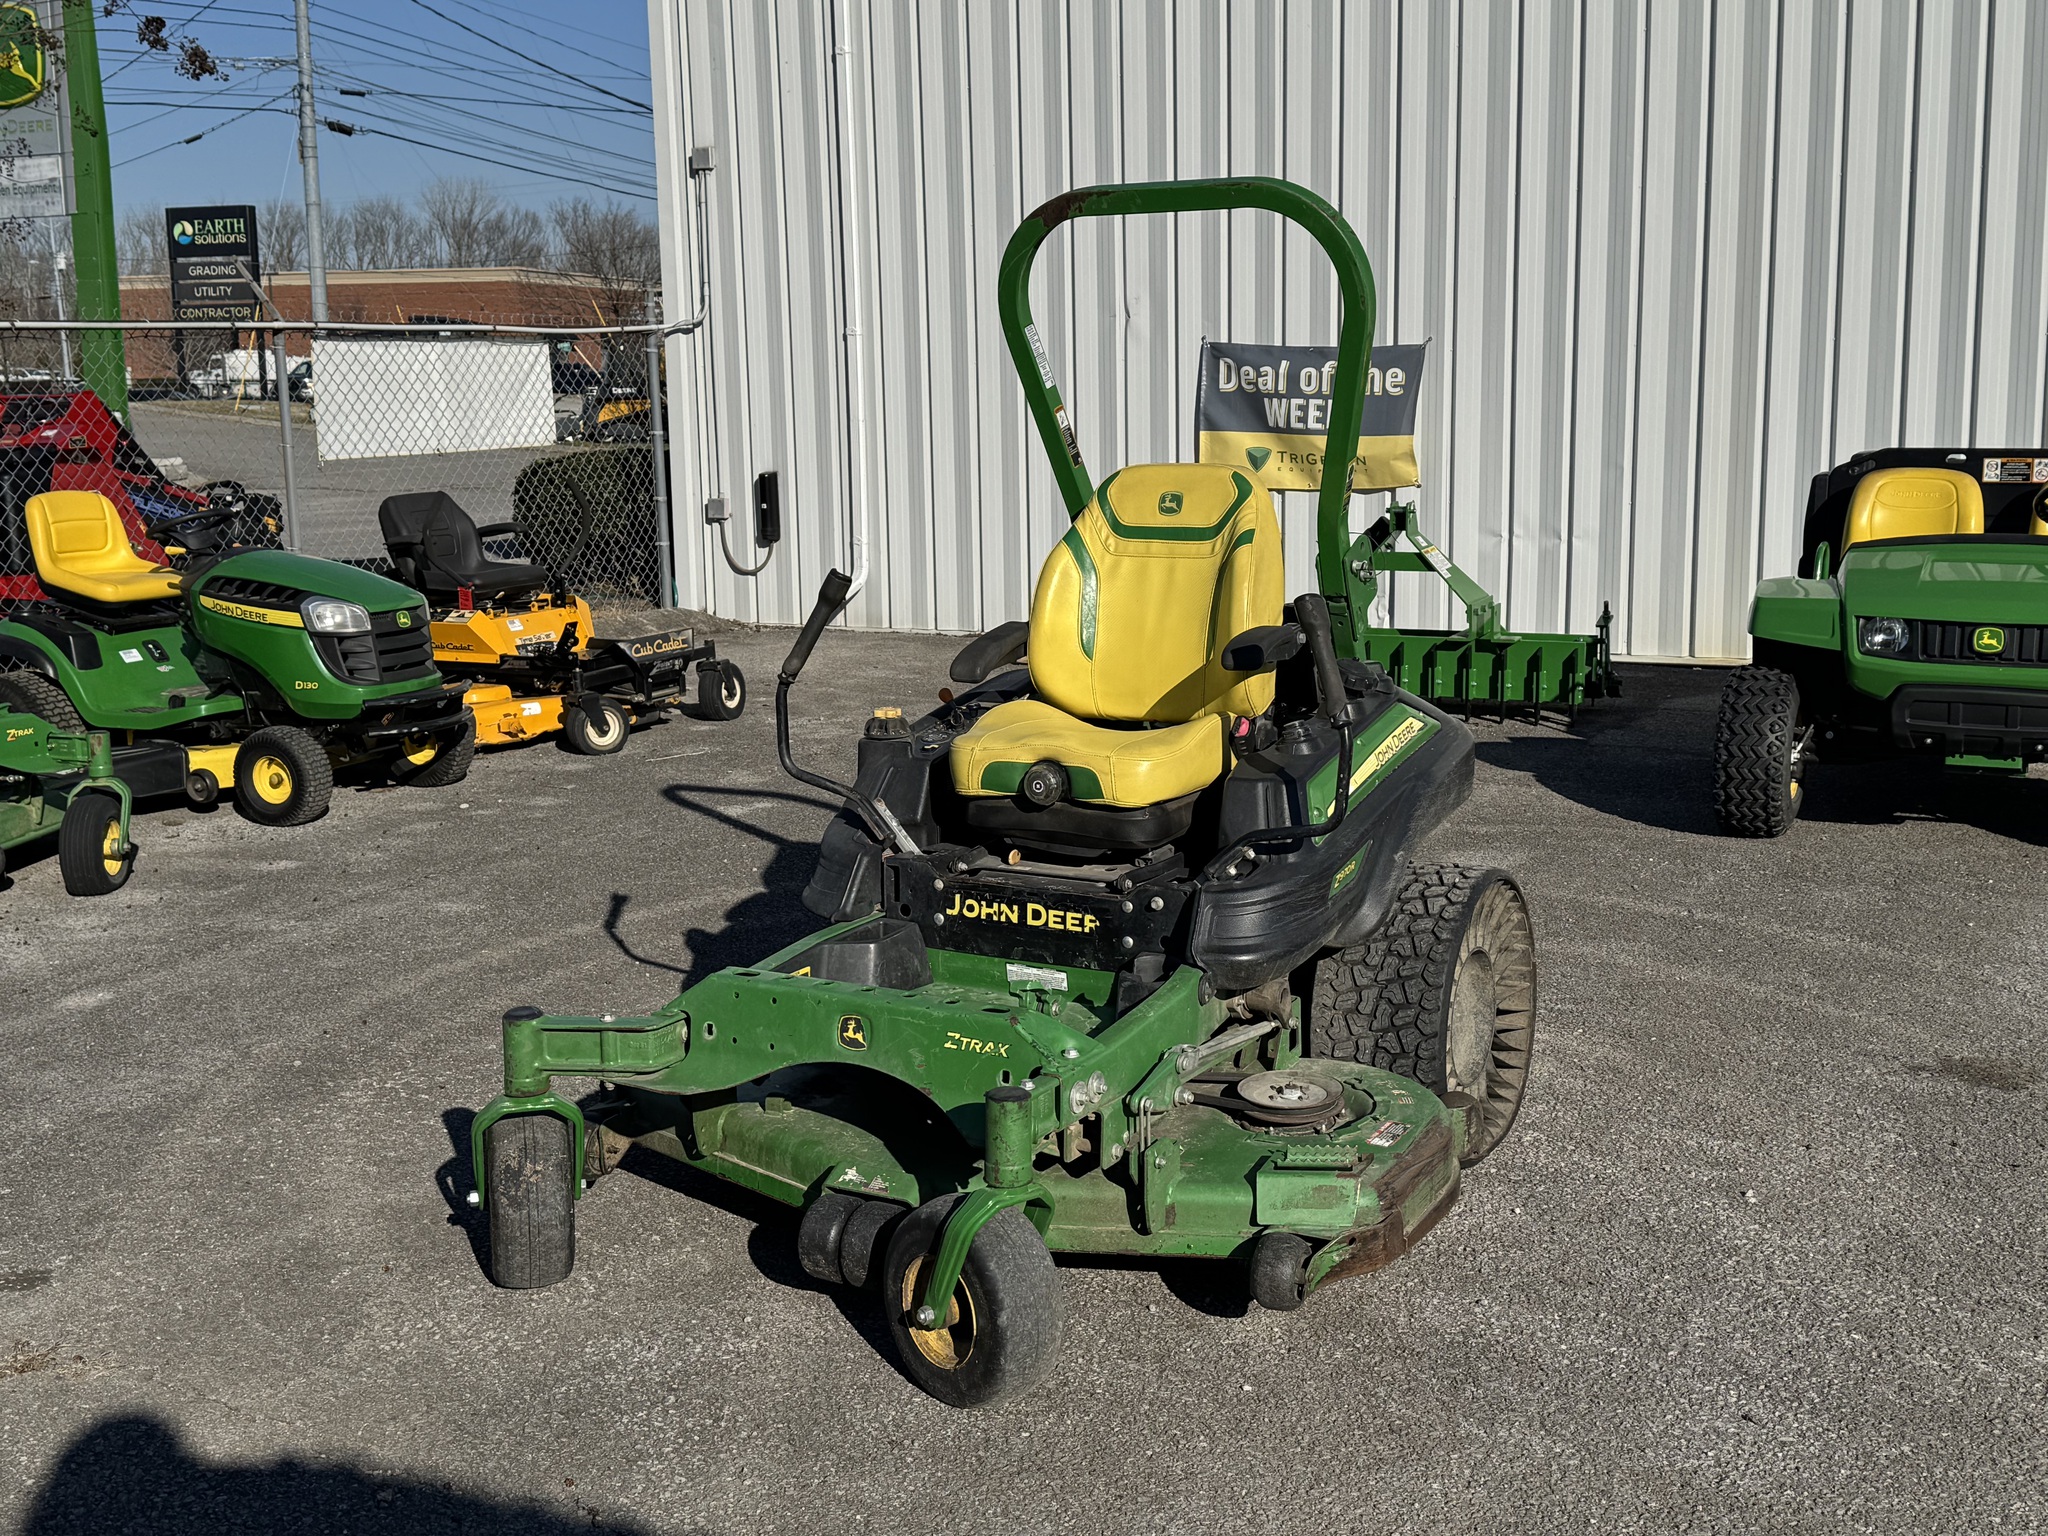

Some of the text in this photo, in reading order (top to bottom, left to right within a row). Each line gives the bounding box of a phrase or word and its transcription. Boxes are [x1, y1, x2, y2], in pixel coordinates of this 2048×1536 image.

[193, 218, 246, 235] EARTH
[193, 232, 247, 245] solutions
[188, 265, 237, 276] GRADING
[193, 286, 233, 297] UTILITY
[180, 306, 252, 319] CONTRACTOR
[1219, 357, 1406, 396] Deal of he
[1263, 397, 1333, 431] WEE
[211, 600, 269, 622] JOHN DEERE
[446, 642, 475, 652] Cadet
[631, 636, 689, 658] Cub Cadet
[295, 680, 319, 690] D130
[1373, 721, 1416, 768] JOHN DEERE
[946, 893, 1019, 924] JOHN
